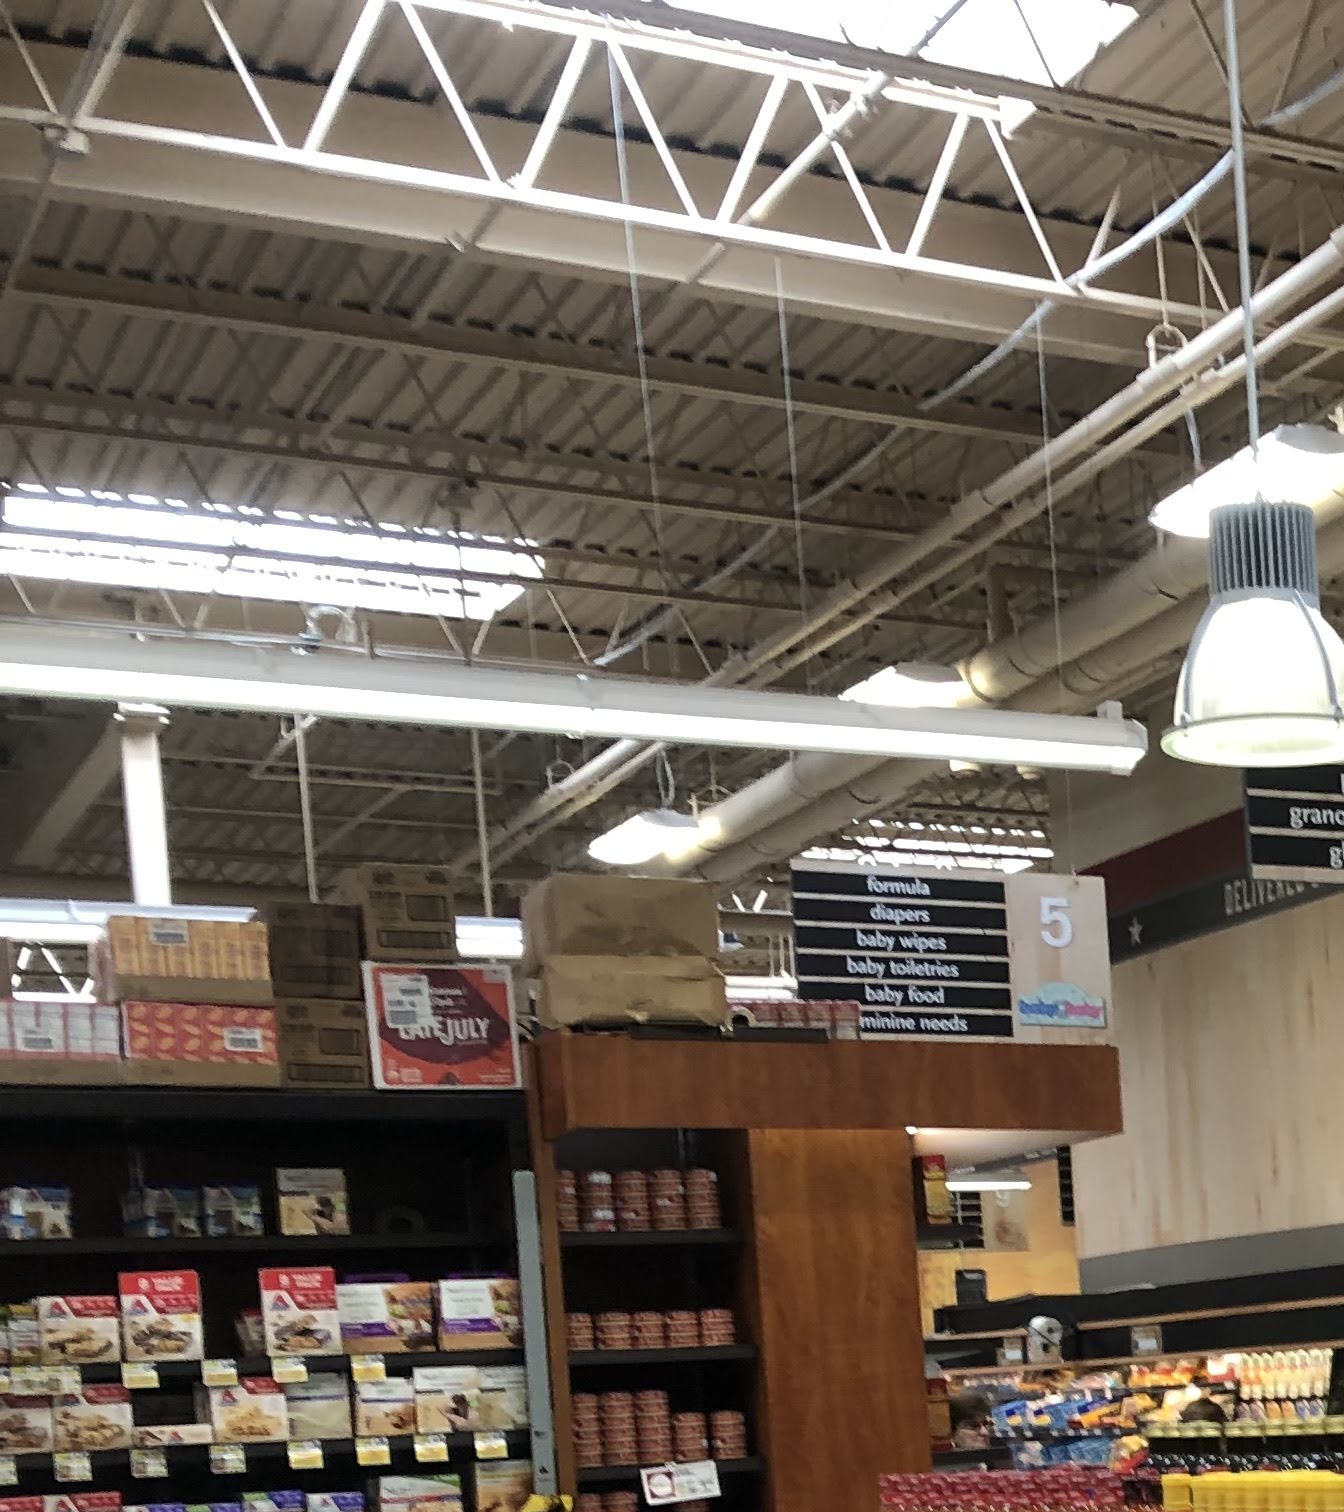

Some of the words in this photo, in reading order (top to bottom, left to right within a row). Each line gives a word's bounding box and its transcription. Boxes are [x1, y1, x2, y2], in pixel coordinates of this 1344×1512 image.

[867, 875, 931, 896] formula
[870, 905, 931, 926] diapers
[1039, 896, 1073, 948] 5
[856, 930, 895, 951] baby
[899, 932, 947, 953] wipes
[846, 956, 884, 978] baby
[890, 957, 960, 979] toiletries
[864, 985, 903, 1006] baby
[907, 986, 945, 1005] food
[440, 1017, 490, 1046] JULY
[860, 1013, 916, 1031] minine
[920, 1015, 968, 1033] needs
